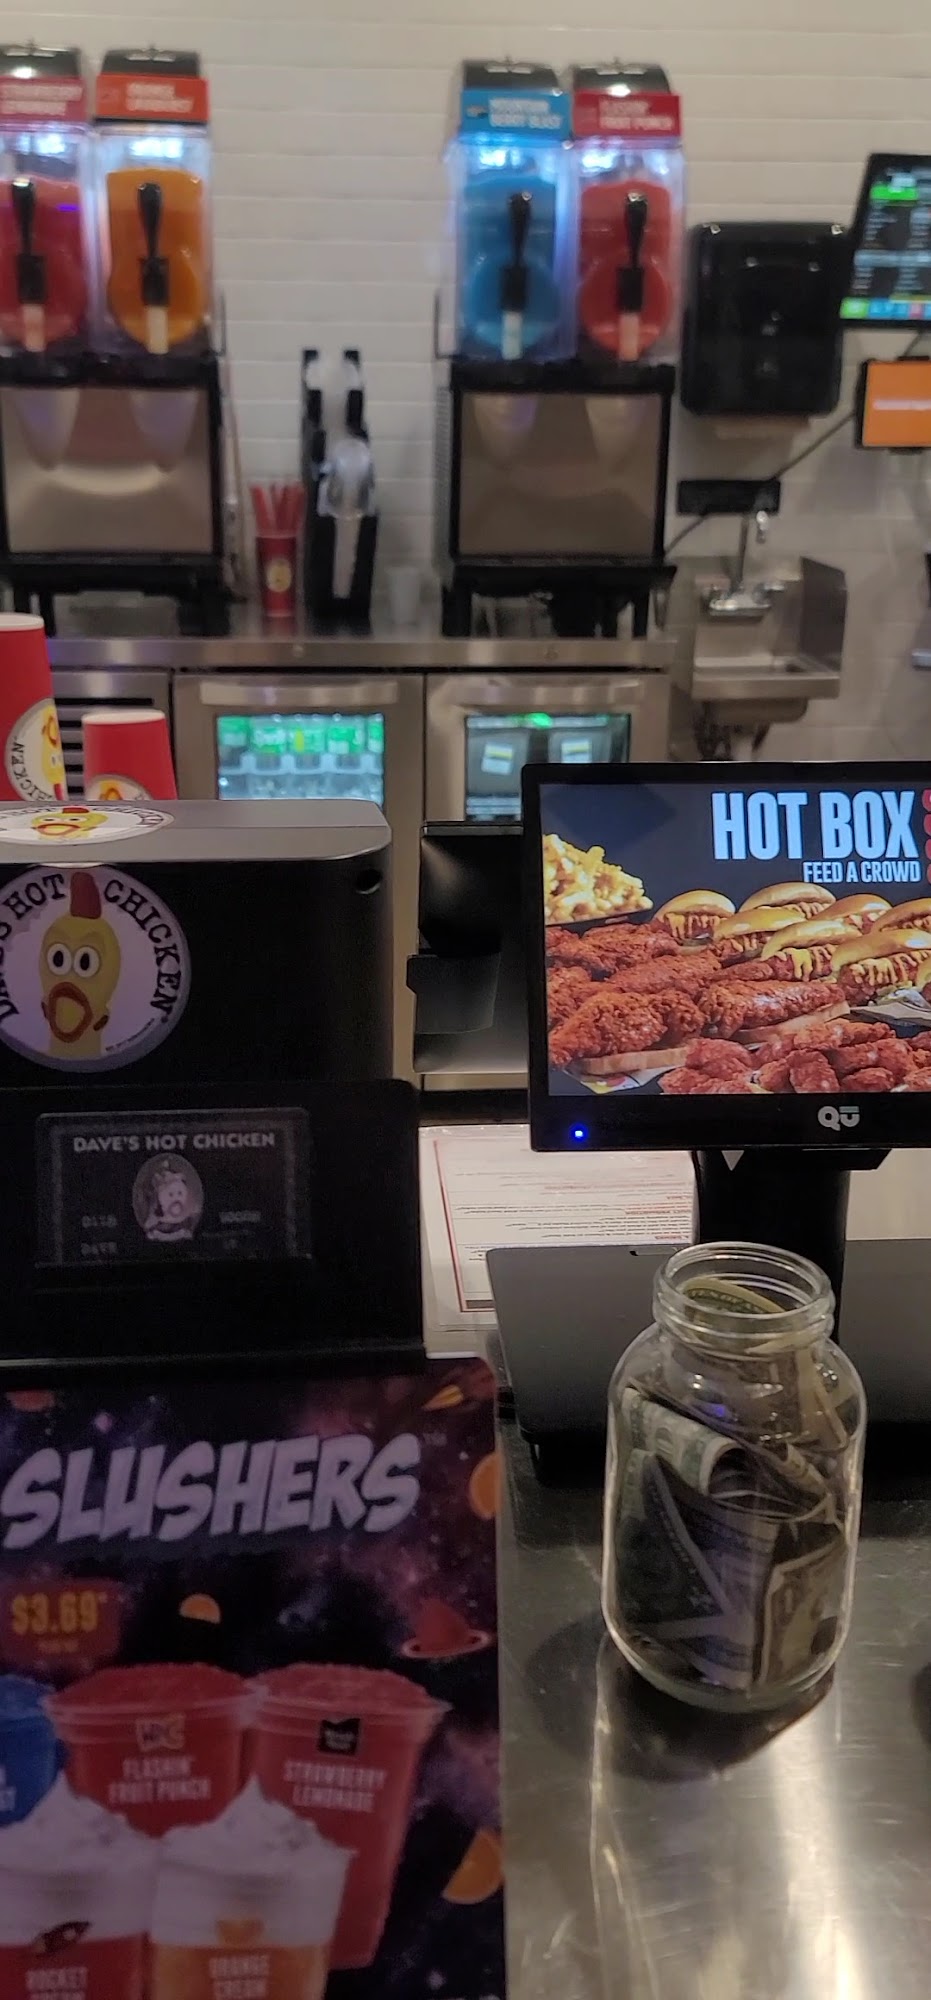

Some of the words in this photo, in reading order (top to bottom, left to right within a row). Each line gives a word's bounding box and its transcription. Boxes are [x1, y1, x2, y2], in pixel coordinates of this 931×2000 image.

[711, 791, 808, 861] HOT
[819, 790, 919, 860] BOX
[802, 861, 842, 884] FEED
[846, 861, 859, 884] A
[860, 860, 922, 883] CROWD
[3, 873, 66, 920] HOT
[104, 879, 182, 1015] CHICKEN
[72, 1136, 140, 1152] DAVE'S
[145, 1134, 188, 1150] HOT
[192, 1132, 276, 1150] CHICKEN
[1, 1432, 421, 1549] SLUSHERS
[283, 1759, 387, 1790] STRAWBERRY
[107, 1780, 154, 1804] FRUIT
[156, 1777, 212, 1801] PUNCH
[291, 1784, 376, 1813] LEMONADE
